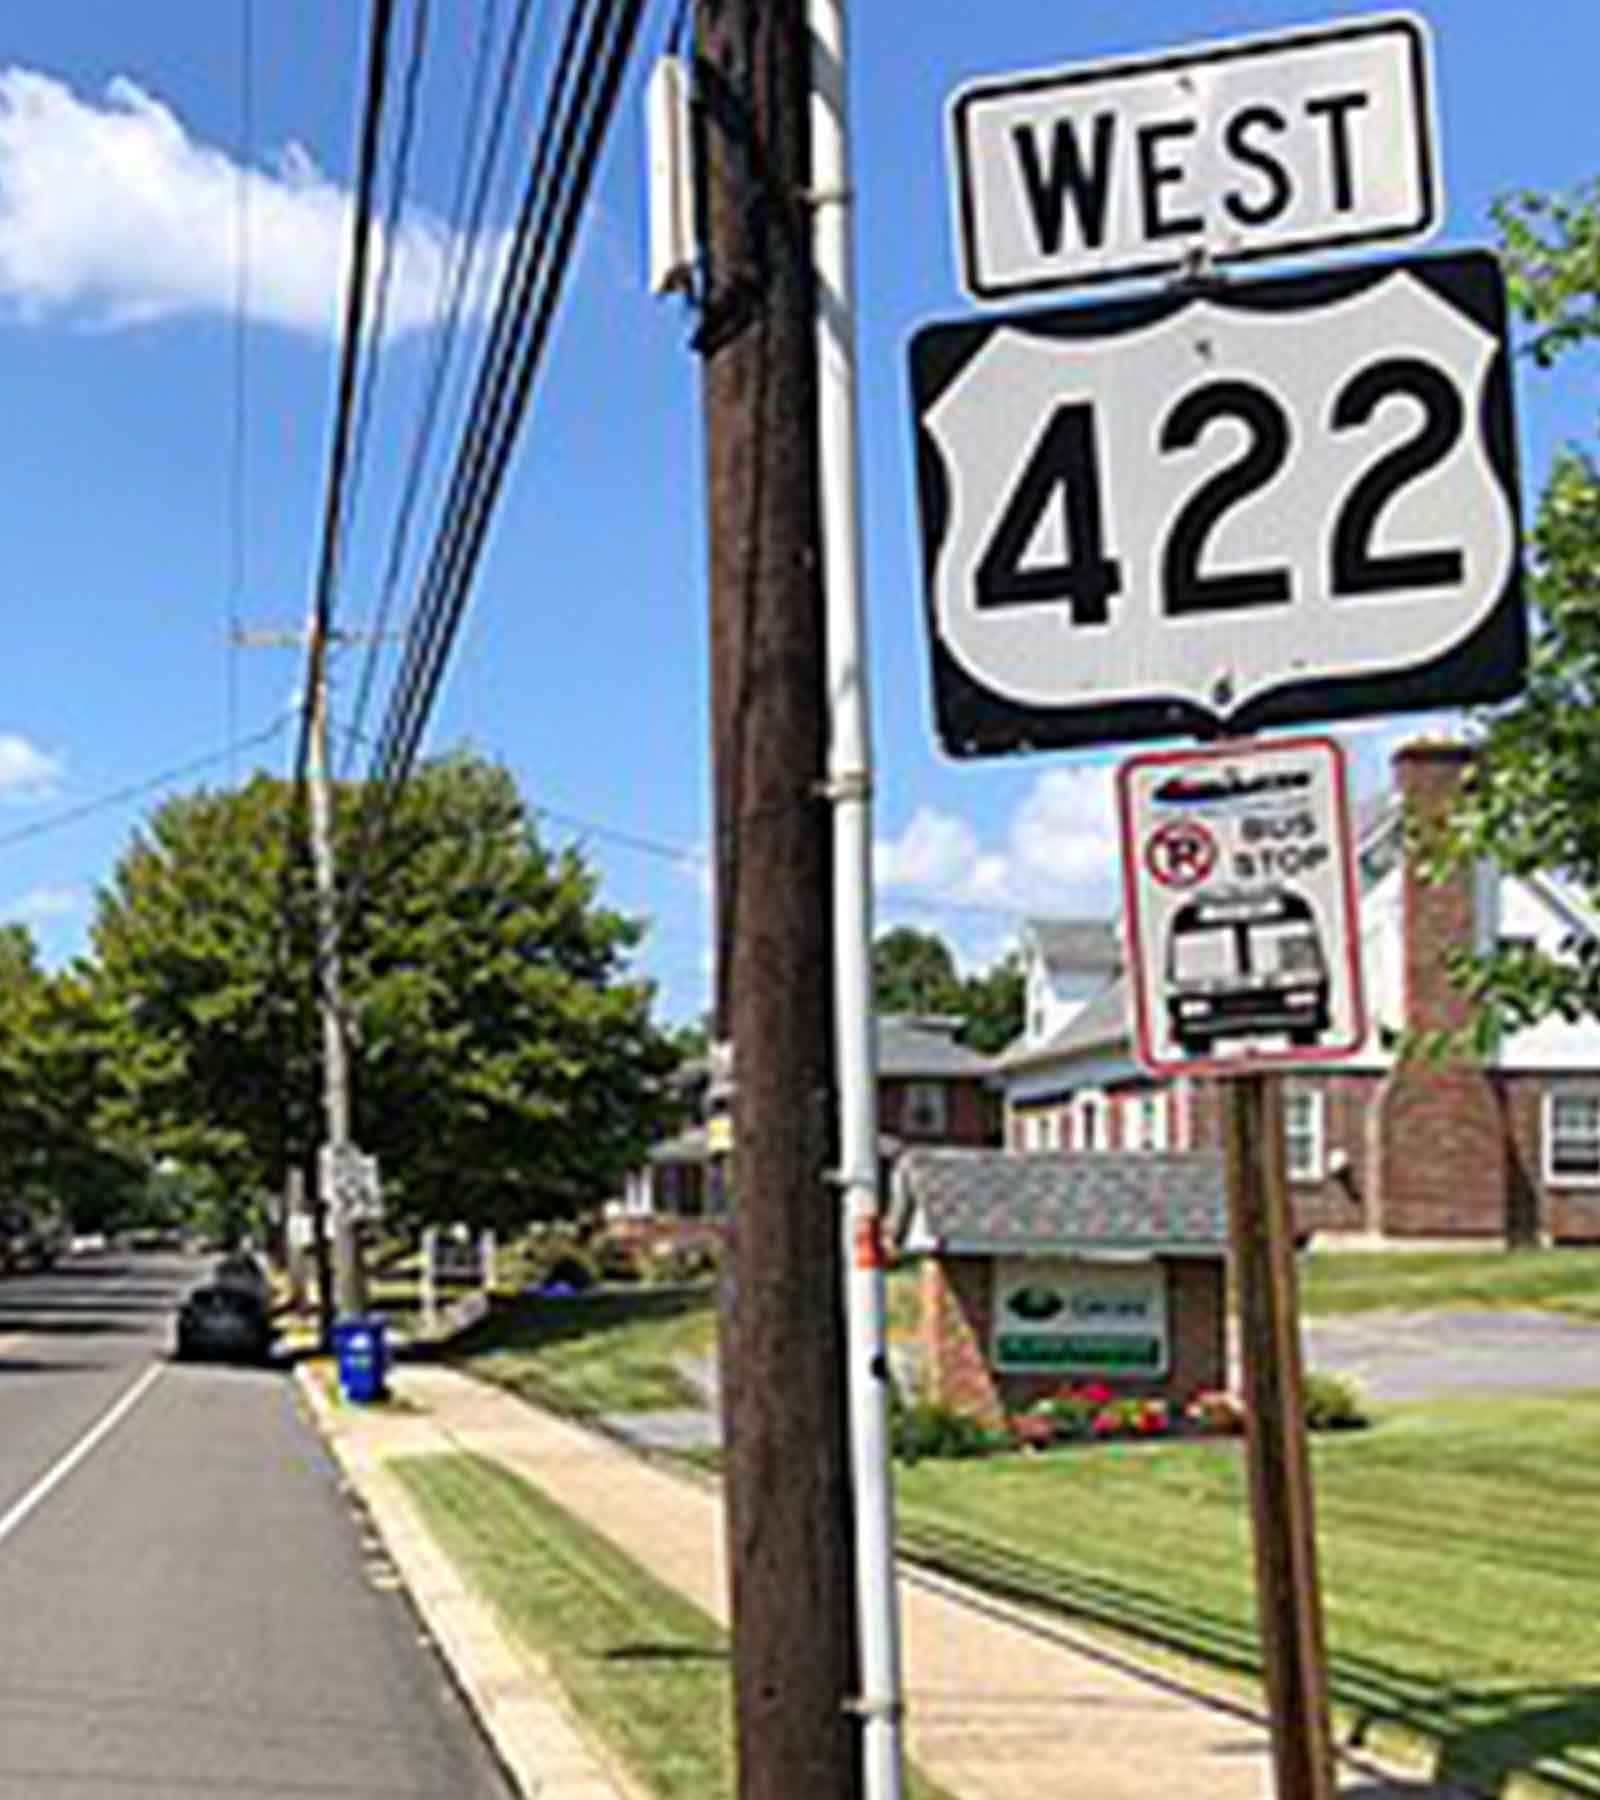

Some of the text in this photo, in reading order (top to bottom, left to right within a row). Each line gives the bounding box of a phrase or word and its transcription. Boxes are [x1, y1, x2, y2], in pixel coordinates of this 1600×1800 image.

[1012, 93, 1369, 256] WEST
[974, 357, 1465, 627] 422
[1234, 845, 1328, 877] STOP
[1241, 811, 1316, 842] BUS
